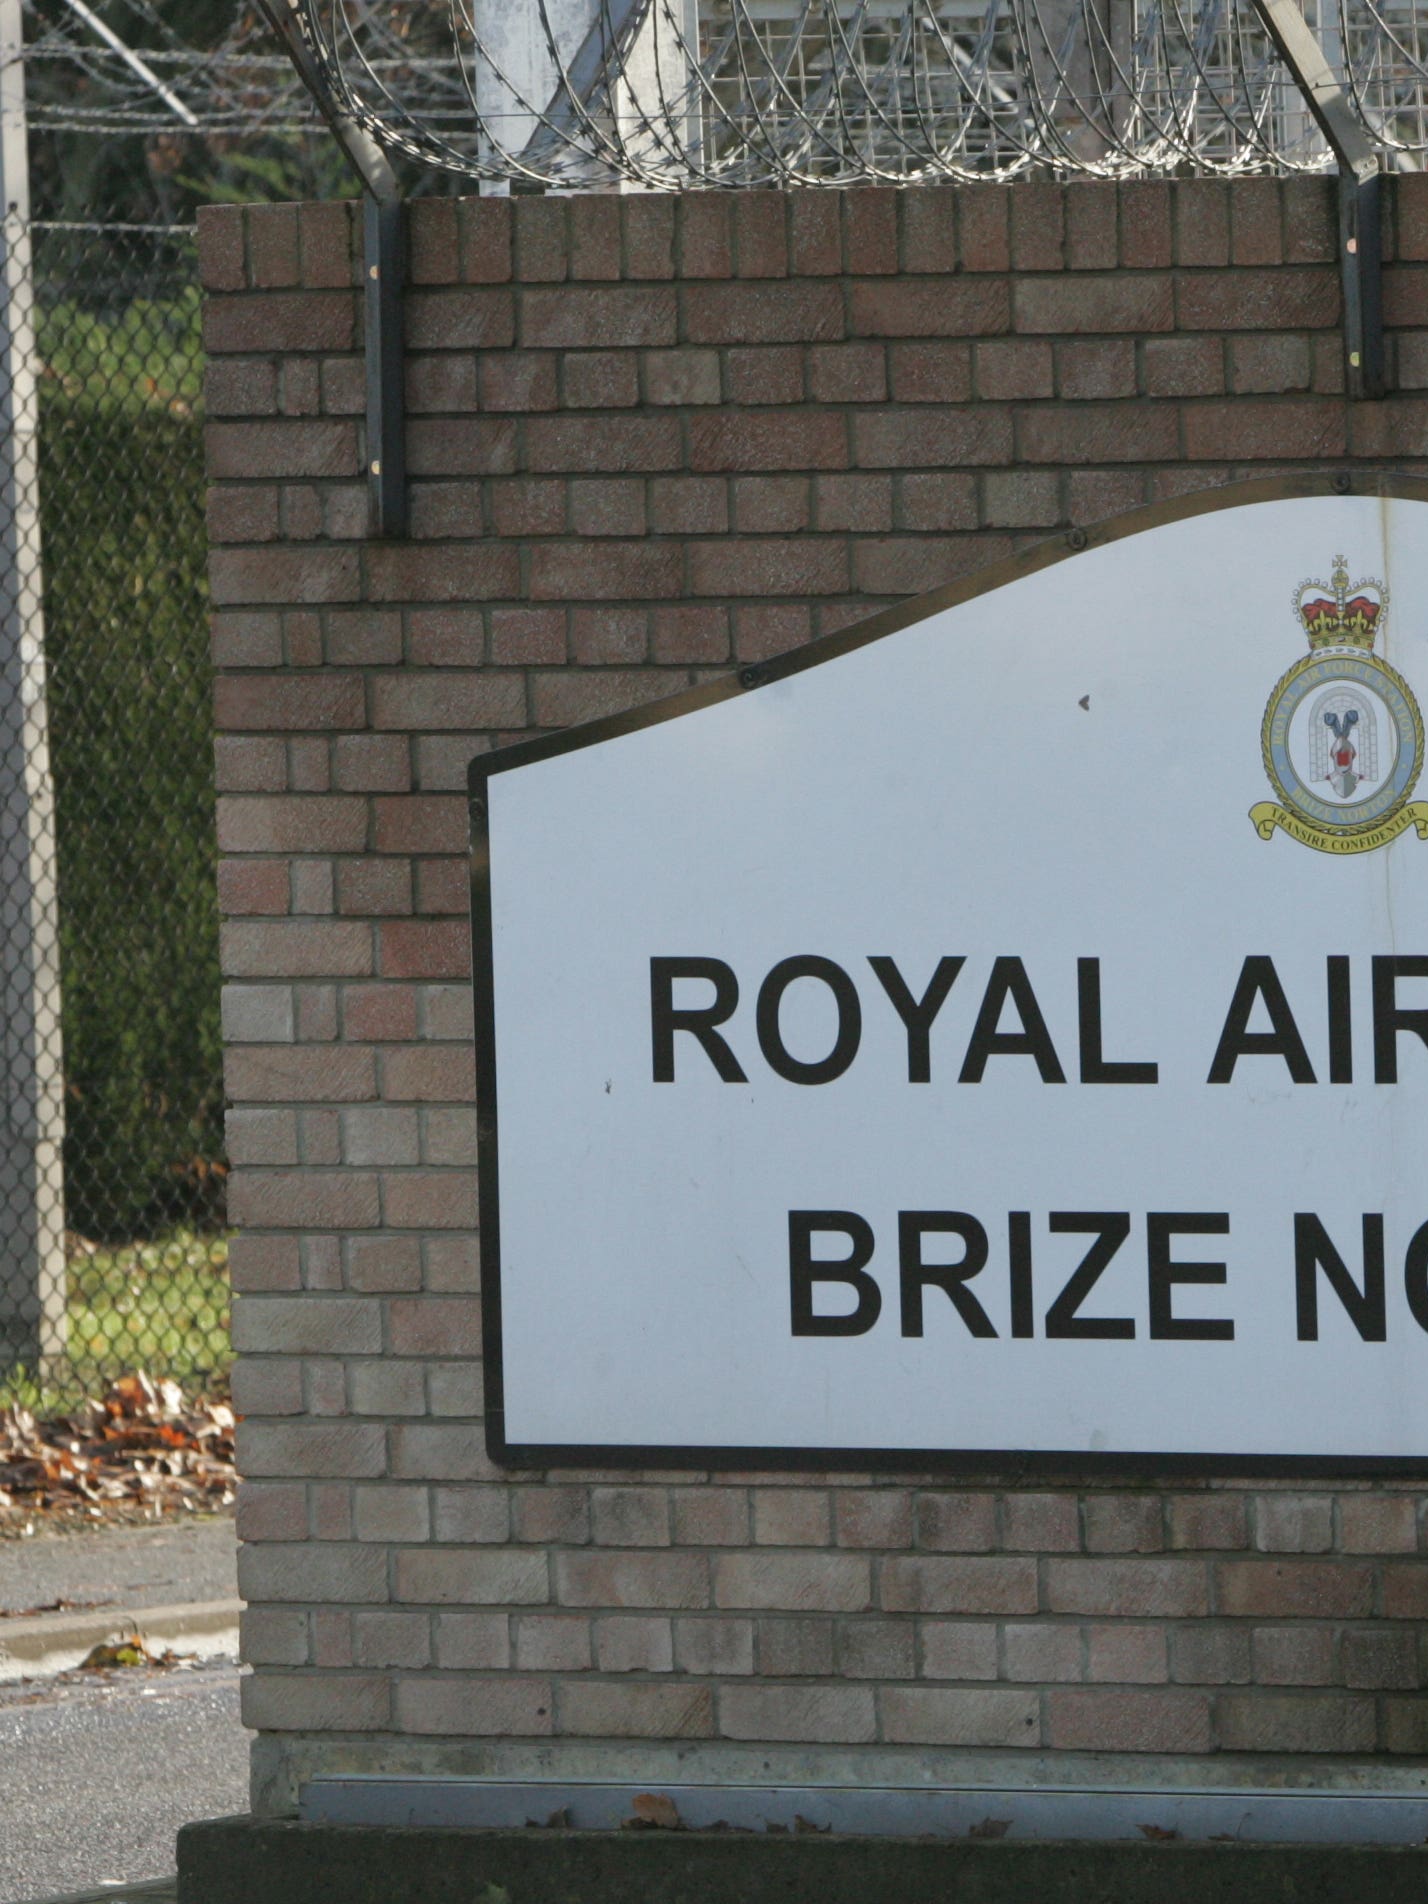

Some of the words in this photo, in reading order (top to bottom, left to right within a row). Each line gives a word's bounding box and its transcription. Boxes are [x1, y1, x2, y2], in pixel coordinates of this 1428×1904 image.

[1271, 806, 1328, 849] TRANSIRE
[1331, 807, 1417, 850] CONFIDENTER
[650, 955, 1158, 1086] ROYAL
[788, 1210, 1235, 1341] BRIZE
